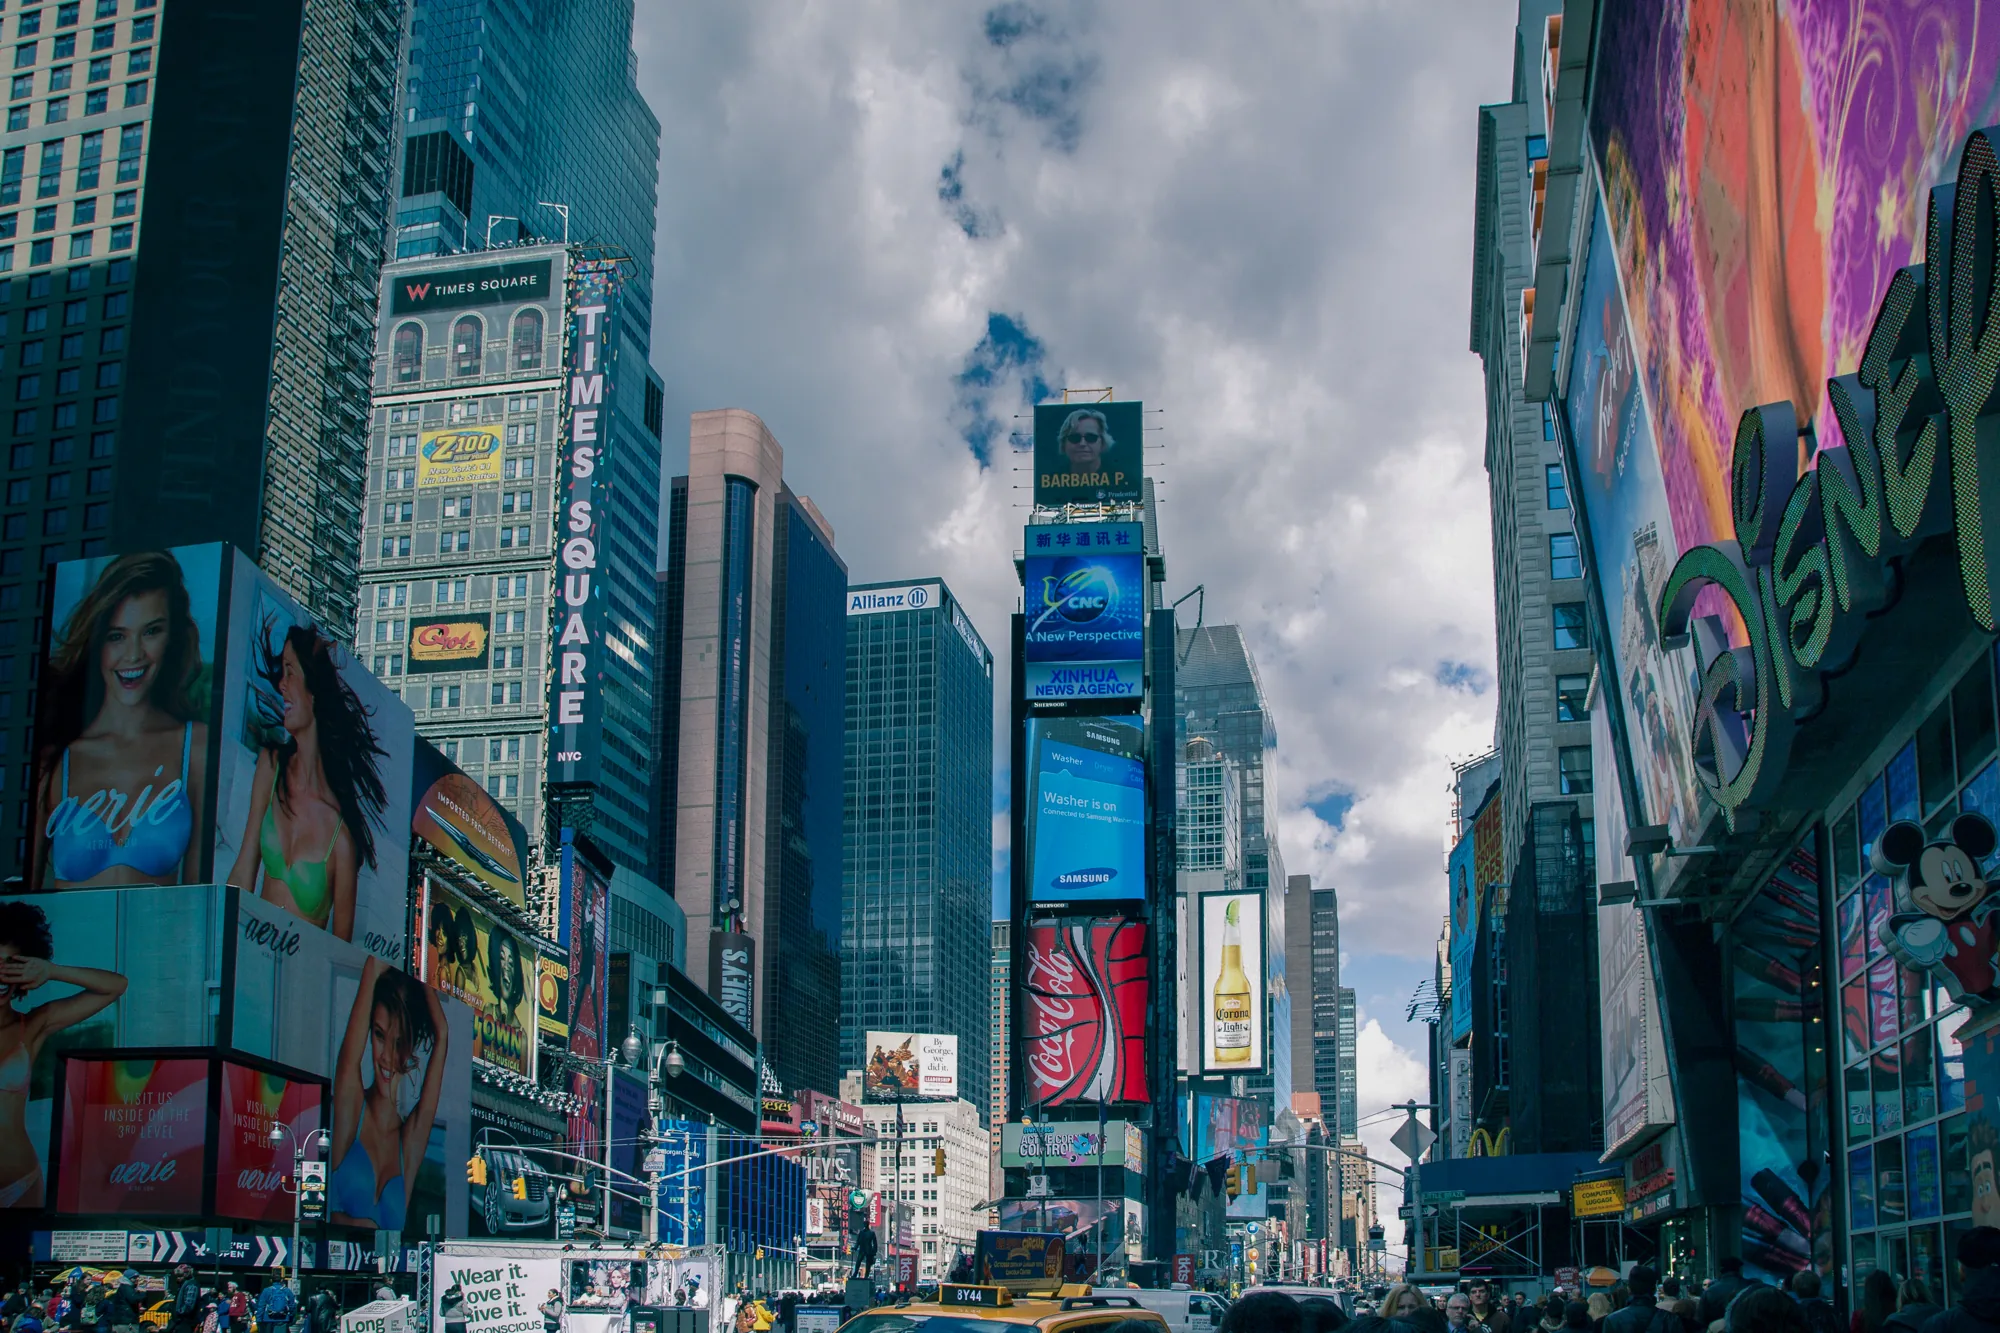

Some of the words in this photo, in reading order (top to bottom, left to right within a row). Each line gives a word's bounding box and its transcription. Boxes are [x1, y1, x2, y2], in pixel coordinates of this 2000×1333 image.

[406, 283, 430, 301] W
[435, 282, 475, 296] TIMES
[480, 275, 537, 291] SQUARE
[572, 305, 606, 478] TIMES
[430, 433, 494, 463] Z100
[421, 477, 436, 485] Hit
[437, 475, 465, 483] Music
[466, 472, 498, 481] Station
[428, 467, 450, 475] New
[1041, 472, 1110, 488] BARBARA
[1114, 471, 1129, 486] P.
[1108, 490, 1138, 498] Prudential
[1036, 531, 1131, 548] 新华通讯社
[851, 594, 904, 611] Allianz
[1068, 596, 1104, 609] CNC
[559, 501, 596, 724] SQUARE
[1026, 633, 1034, 642] A
[1037, 632, 1065, 642] New
[1068, 628, 1142, 643] Perspective
[1051, 668, 1119, 684] XINHUA
[1035, 683, 1075, 696] NEWS
[1077, 682, 1134, 696] AGENCY
[1086, 730, 1121, 746] SAMSUNG
[557, 751, 583, 762] NYC
[1051, 752, 1083, 766] Washer
[1094, 761, 1115, 773] Dryer
[45, 764, 183, 839] aerie
[1043, 791, 1089, 808] Washer
[1092, 798, 1101, 810] is
[1103, 801, 1117, 812] on
[1043, 807, 1078, 818] Connected
[1086, 812, 1112, 823] Samsung
[437, 791, 470, 825] IMPORTED
[471, 817, 487, 837] FROM
[487, 832, 513, 857] DETROIT
[1474, 795, 1500, 852] THE
[1059, 874, 1110, 884] SAMSUNG
[245, 917, 300, 957] aerie
[364, 931, 402, 961] aerie
[441, 979, 451, 993] ON
[452, 985, 483, 1007] BROADWAY
[539, 972, 558, 1016] Q
[1215, 1008, 1250, 1022] Corona
[1222, 1022, 1243, 1033] Light
[934, 1038, 944, 1046] By
[923, 1046, 953, 1056] George,
[484, 1048, 495, 1062] THE
[496, 1054, 521, 1073] MUSICAL
[928, 1063, 940, 1071] did
[941, 1063, 949, 1072] it.
[123, 1092, 153, 1105] VISIT
[157, 1091, 173, 1105] US
[104, 1108, 143, 1122] INSIDE
[149, 1108, 165, 1122] ON
[169, 1108, 189, 1122] THE
[247, 1099, 266, 1116] VISIT
[234, 1113, 260, 1131] INSIDE
[118, 1125, 136, 1138] 3RD
[140, 1125, 175, 1139] LEVEL
[532, 1127, 553, 1141] EDITION
[110, 1152, 177, 1184] aerie
[237, 1164, 281, 1192] aerie
[1574, 1184, 1594, 1192] DIGITAL
[1582, 1189, 1616, 1199] COMPUTERS
[1586, 1197, 1613, 1206] LUGGAGE
[1402, 1208, 1414, 1217] ON
[451, 1268, 504, 1286] Wear
[508, 1262, 528, 1280] it.
[900, 1257, 912, 1282] tkts
[1178, 1256, 1191, 1282] tkts
[467, 1287, 501, 1304] ove
[506, 1282, 526, 1299] it.
[957, 1289, 982, 1302] 8Y44
[507, 1301, 527, 1317] it.
[346, 1316, 385, 1333] Long
[469, 1320, 543, 1333] #CONSCIOUS
